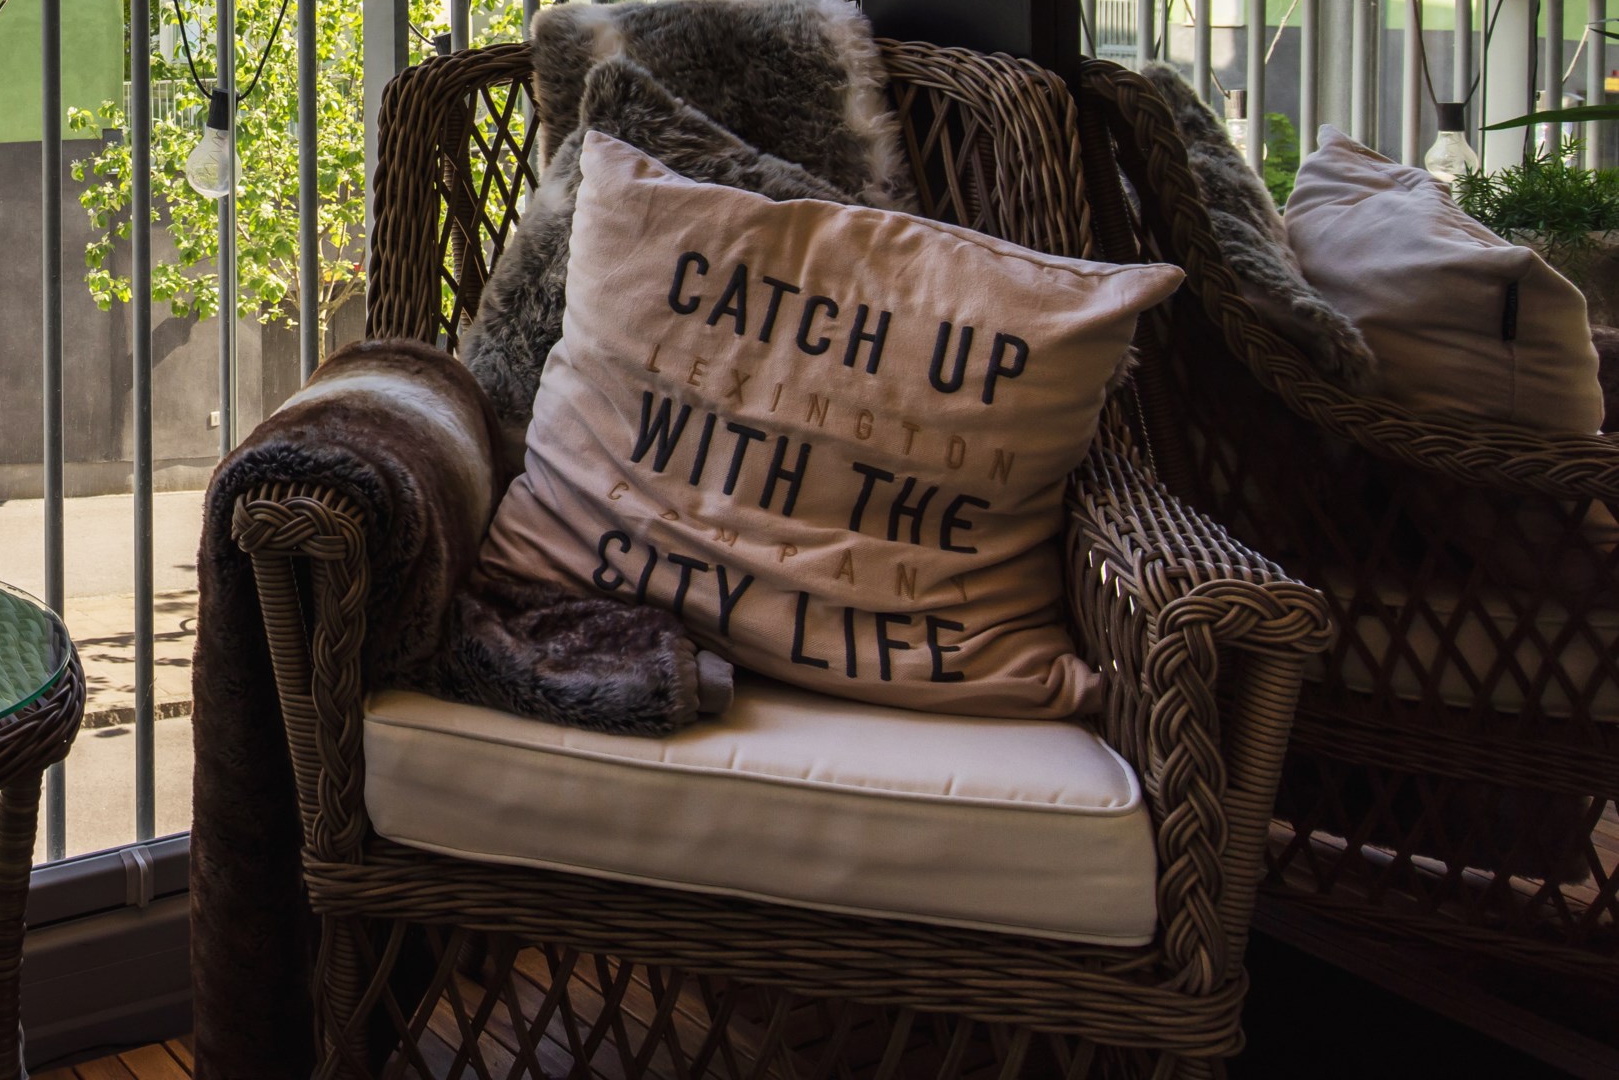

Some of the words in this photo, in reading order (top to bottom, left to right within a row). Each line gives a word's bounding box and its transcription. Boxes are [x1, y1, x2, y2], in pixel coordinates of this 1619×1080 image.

[666, 250, 892, 375] CATCH
[927, 319, 1030, 405] UP
[629, 391, 813, 517] WITH
[851, 461, 991, 554] THE
[646, 342, 1016, 486] LEXINGTON
[591, 529, 756, 637] CITY
[790, 590, 966, 683] LIFE
